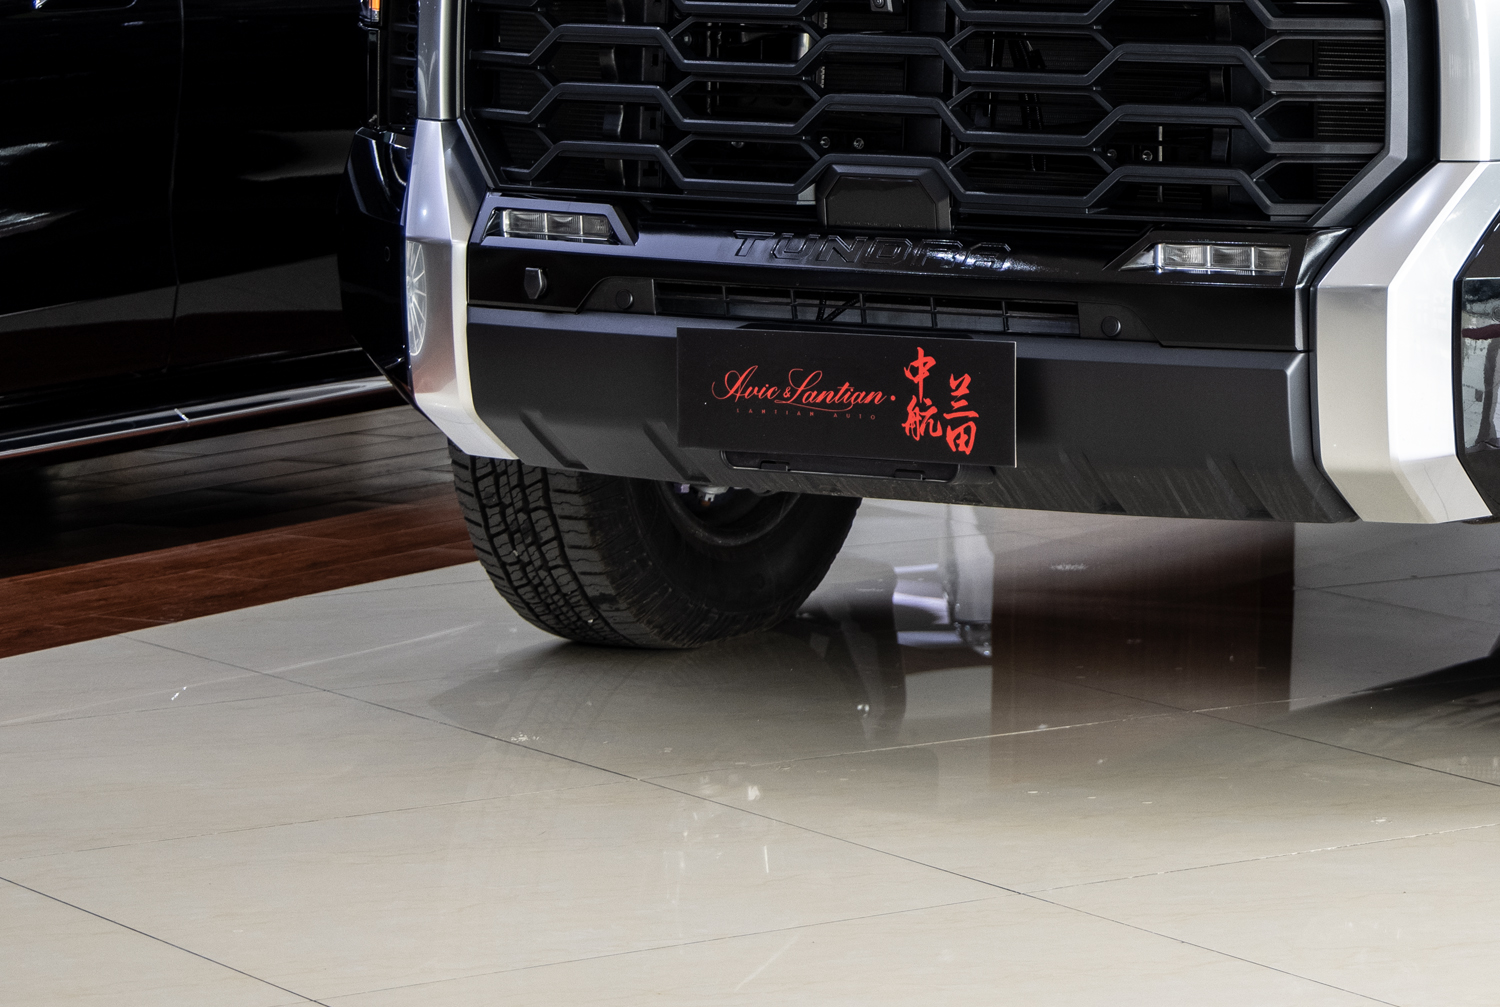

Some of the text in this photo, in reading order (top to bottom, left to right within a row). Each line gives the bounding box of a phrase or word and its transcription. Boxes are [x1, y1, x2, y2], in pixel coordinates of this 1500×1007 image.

[733, 229, 1012, 271] TUNDRA
[736, 408, 876, 421] LANTIAN AUTO
